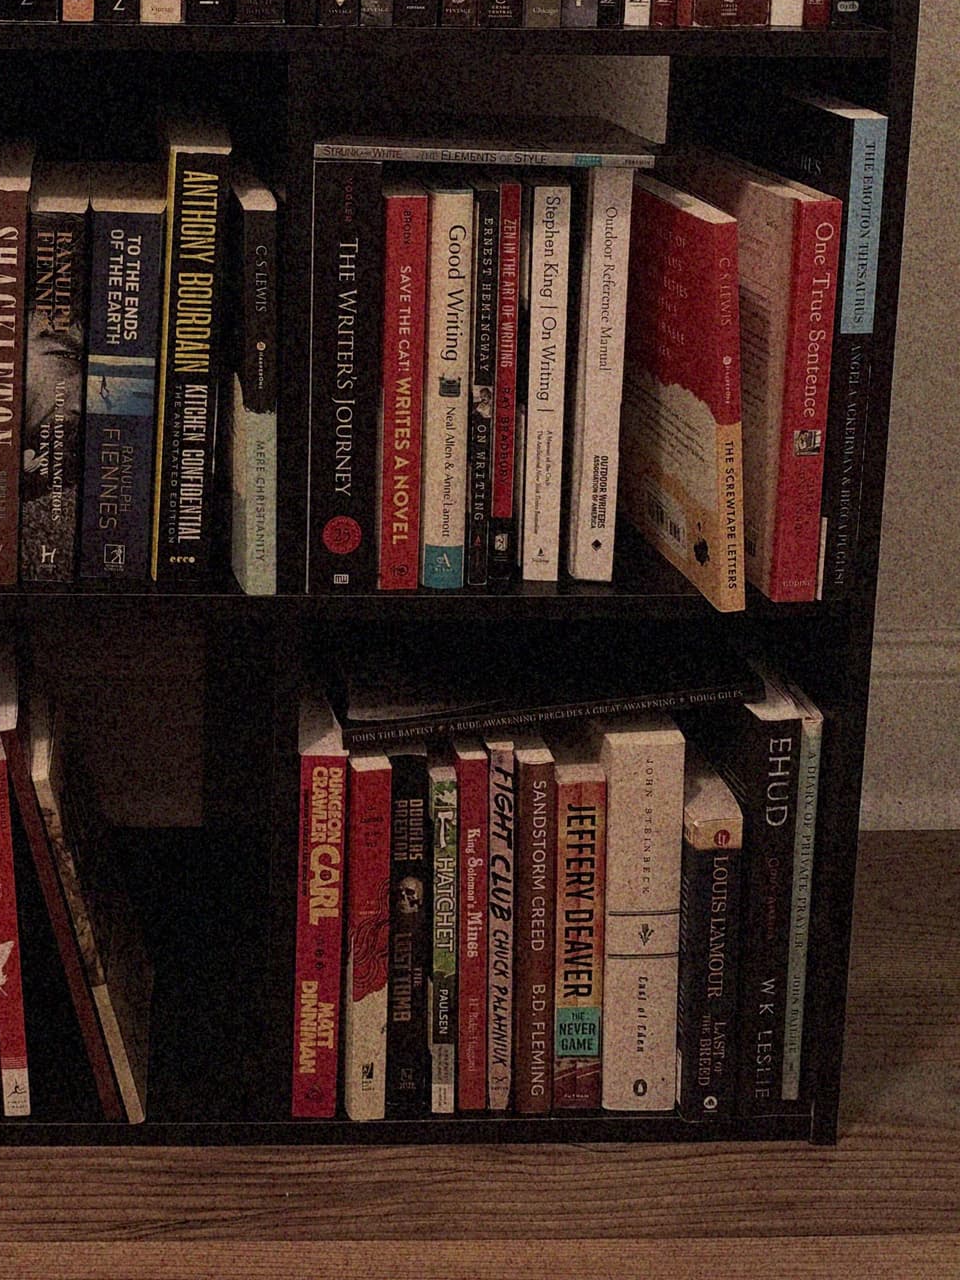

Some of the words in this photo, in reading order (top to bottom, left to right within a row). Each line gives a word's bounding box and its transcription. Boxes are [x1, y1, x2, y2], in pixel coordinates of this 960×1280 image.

[111, 229, 124, 250] OF
[180, 171, 219, 263] ANTHONY
[544, 196, 561, 256] Stephen
[127, 236, 142, 256] TO
[339, 238, 358, 281] THE
[448, 225, 467, 279] Good
[814, 222, 833, 265] One
[109, 257, 123, 287] THE
[126, 265, 141, 292] THE
[540, 262, 559, 299] King
[107, 295, 122, 345] EARTH
[124, 299, 140, 340] ENDS
[173, 272, 213, 373] BOURDAIN
[441, 289, 465, 361] Writing
[810, 278, 830, 322] True
[336, 290, 357, 388] WRITER'S
[541, 317, 556, 339] On
[537, 344, 556, 401] Writing
[803, 330, 826, 417] Sentence
[183, 385, 208, 442] KITCHEN
[446, 406, 456, 428] Neal
[332, 399, 355, 496] JOURNEY
[443, 432, 454, 459] Allen
[443, 463, 453, 471] &
[99, 428, 121, 529] FIENNES
[178, 449, 205, 541] CONFIDENTIAL
[442, 476, 451, 501] Anne
[600, 456, 608, 494] OUTDOOR
[440, 507, 451, 537] Lamott
[597, 496, 607, 529] WRITERS
[352, 735, 376, 743] JOHN
[378, 732, 395, 740] THE
[398, 726, 434, 738] BAPTIST
[646, 760, 654, 798] JOHN
[766, 738, 791, 826] EHUD
[328, 767, 343, 843] DUNGEON
[409, 799, 423, 861] DOUGLAS
[493, 767, 513, 849] FIGHT
[531, 781, 546, 892] SANDSTORM
[566, 804, 596, 900] JEFFERY
[642, 809, 652, 894] STEINBECK
[490, 855, 511, 922] CLUB
[531, 897, 545, 951] CREED
[564, 910, 593, 998] DEAVER
[439, 989, 448, 1034] PAULSEN
[560, 1024, 596, 1035] NEVER
[561, 1040, 593, 1050] GAME
